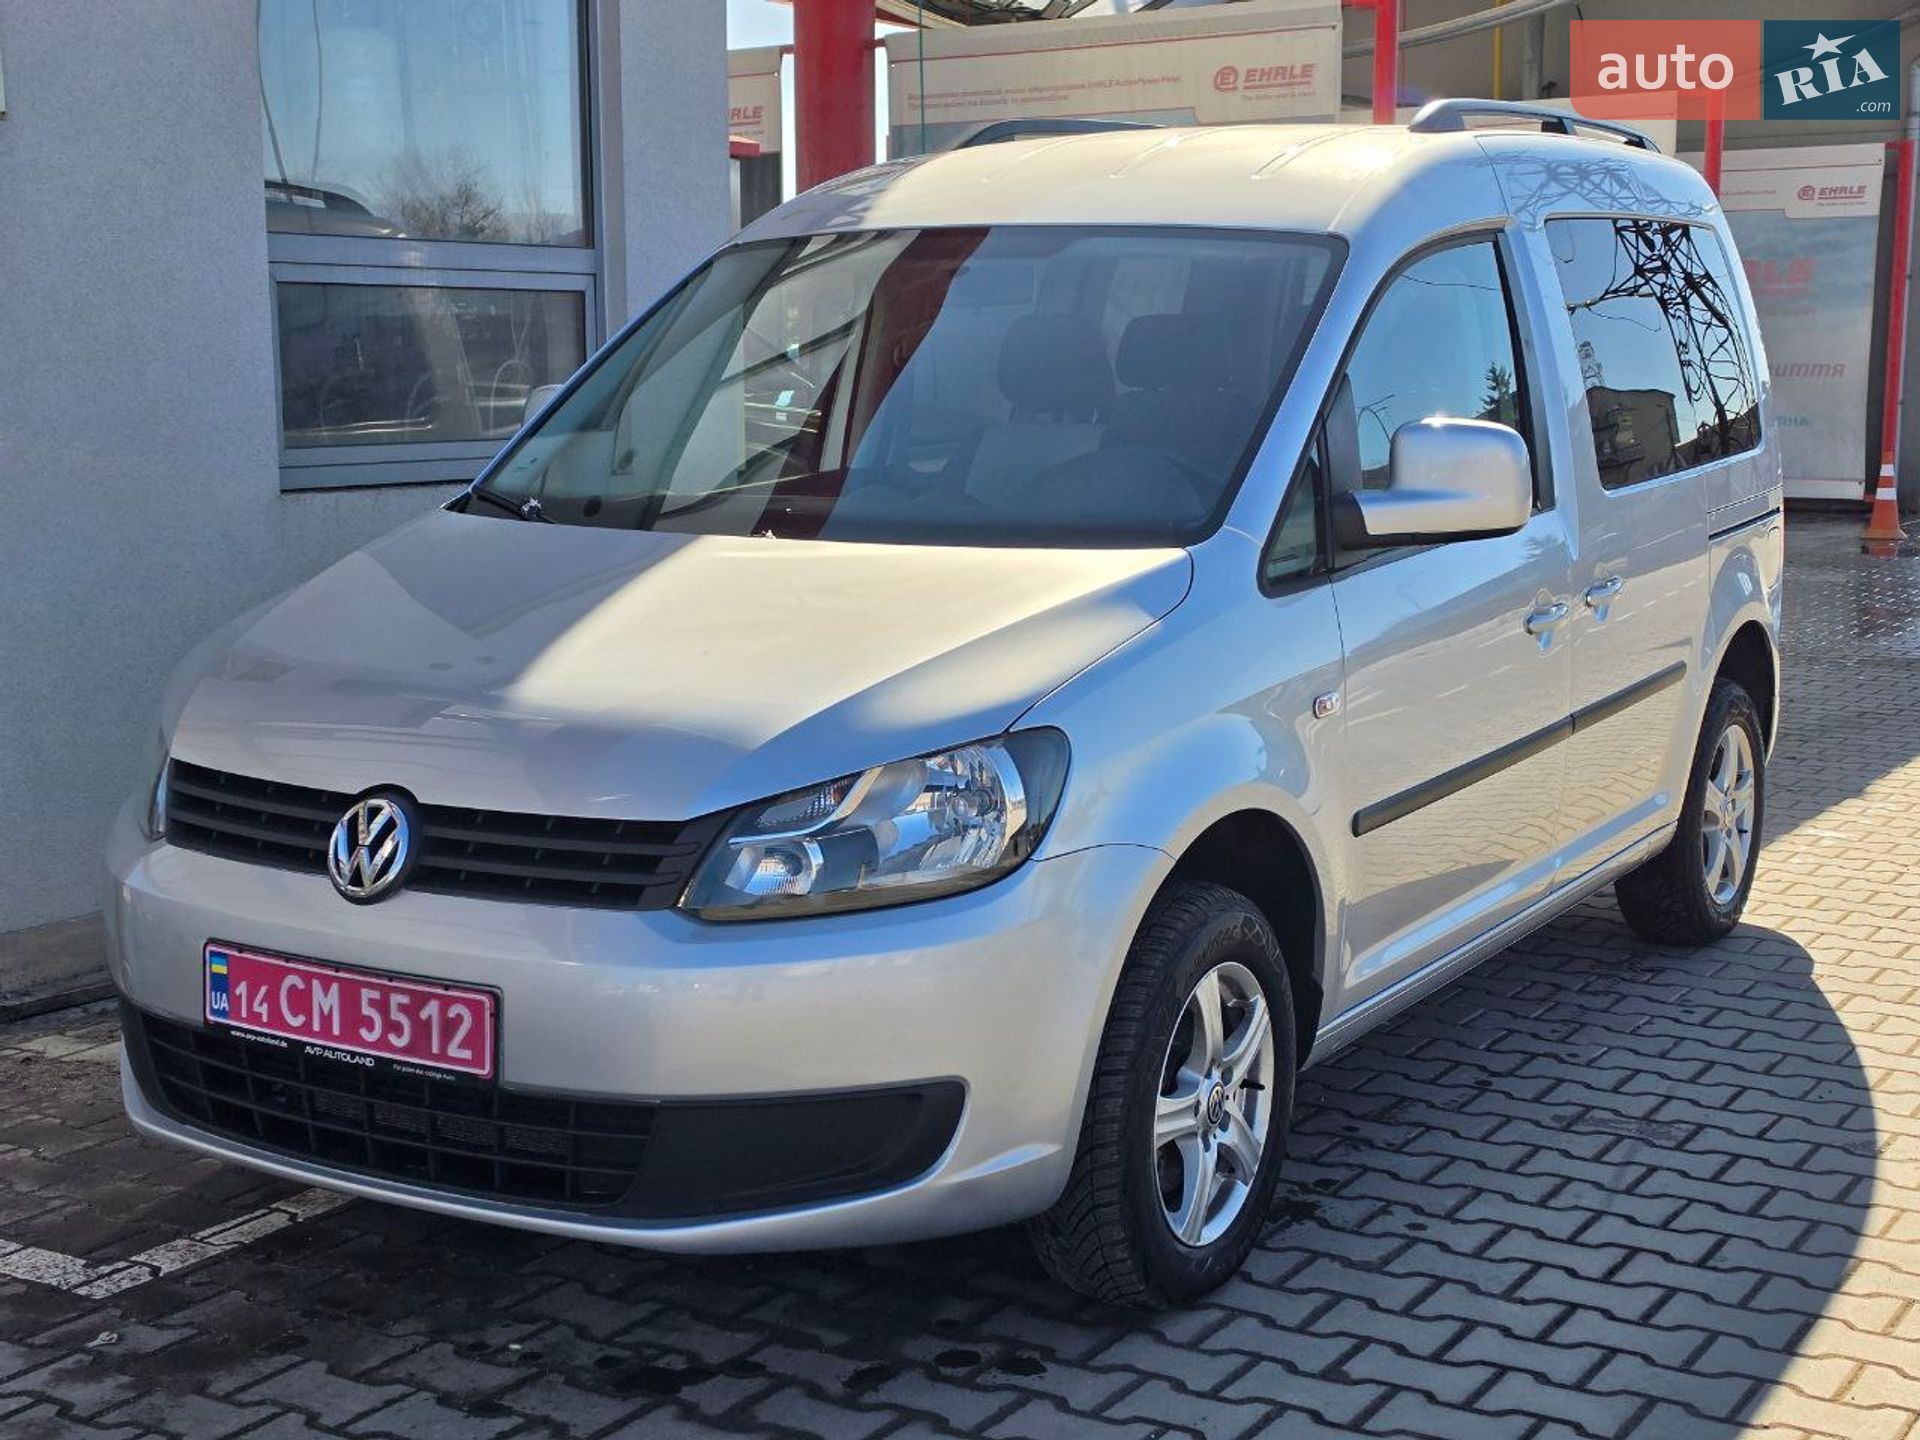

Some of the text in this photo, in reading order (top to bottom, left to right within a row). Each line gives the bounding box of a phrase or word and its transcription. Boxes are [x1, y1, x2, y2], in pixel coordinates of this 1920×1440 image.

[1244, 63, 1317, 83] EHRLE
[728, 105, 763, 120] RLE
[1818, 185, 1867, 196] EHRLE
[1774, 363, 1846, 378] иття
[211, 990, 230, 1012] UA
[234, 974, 474, 1060] 14 CM 5512
[323, 1049, 375, 1067] AUTOLAND
